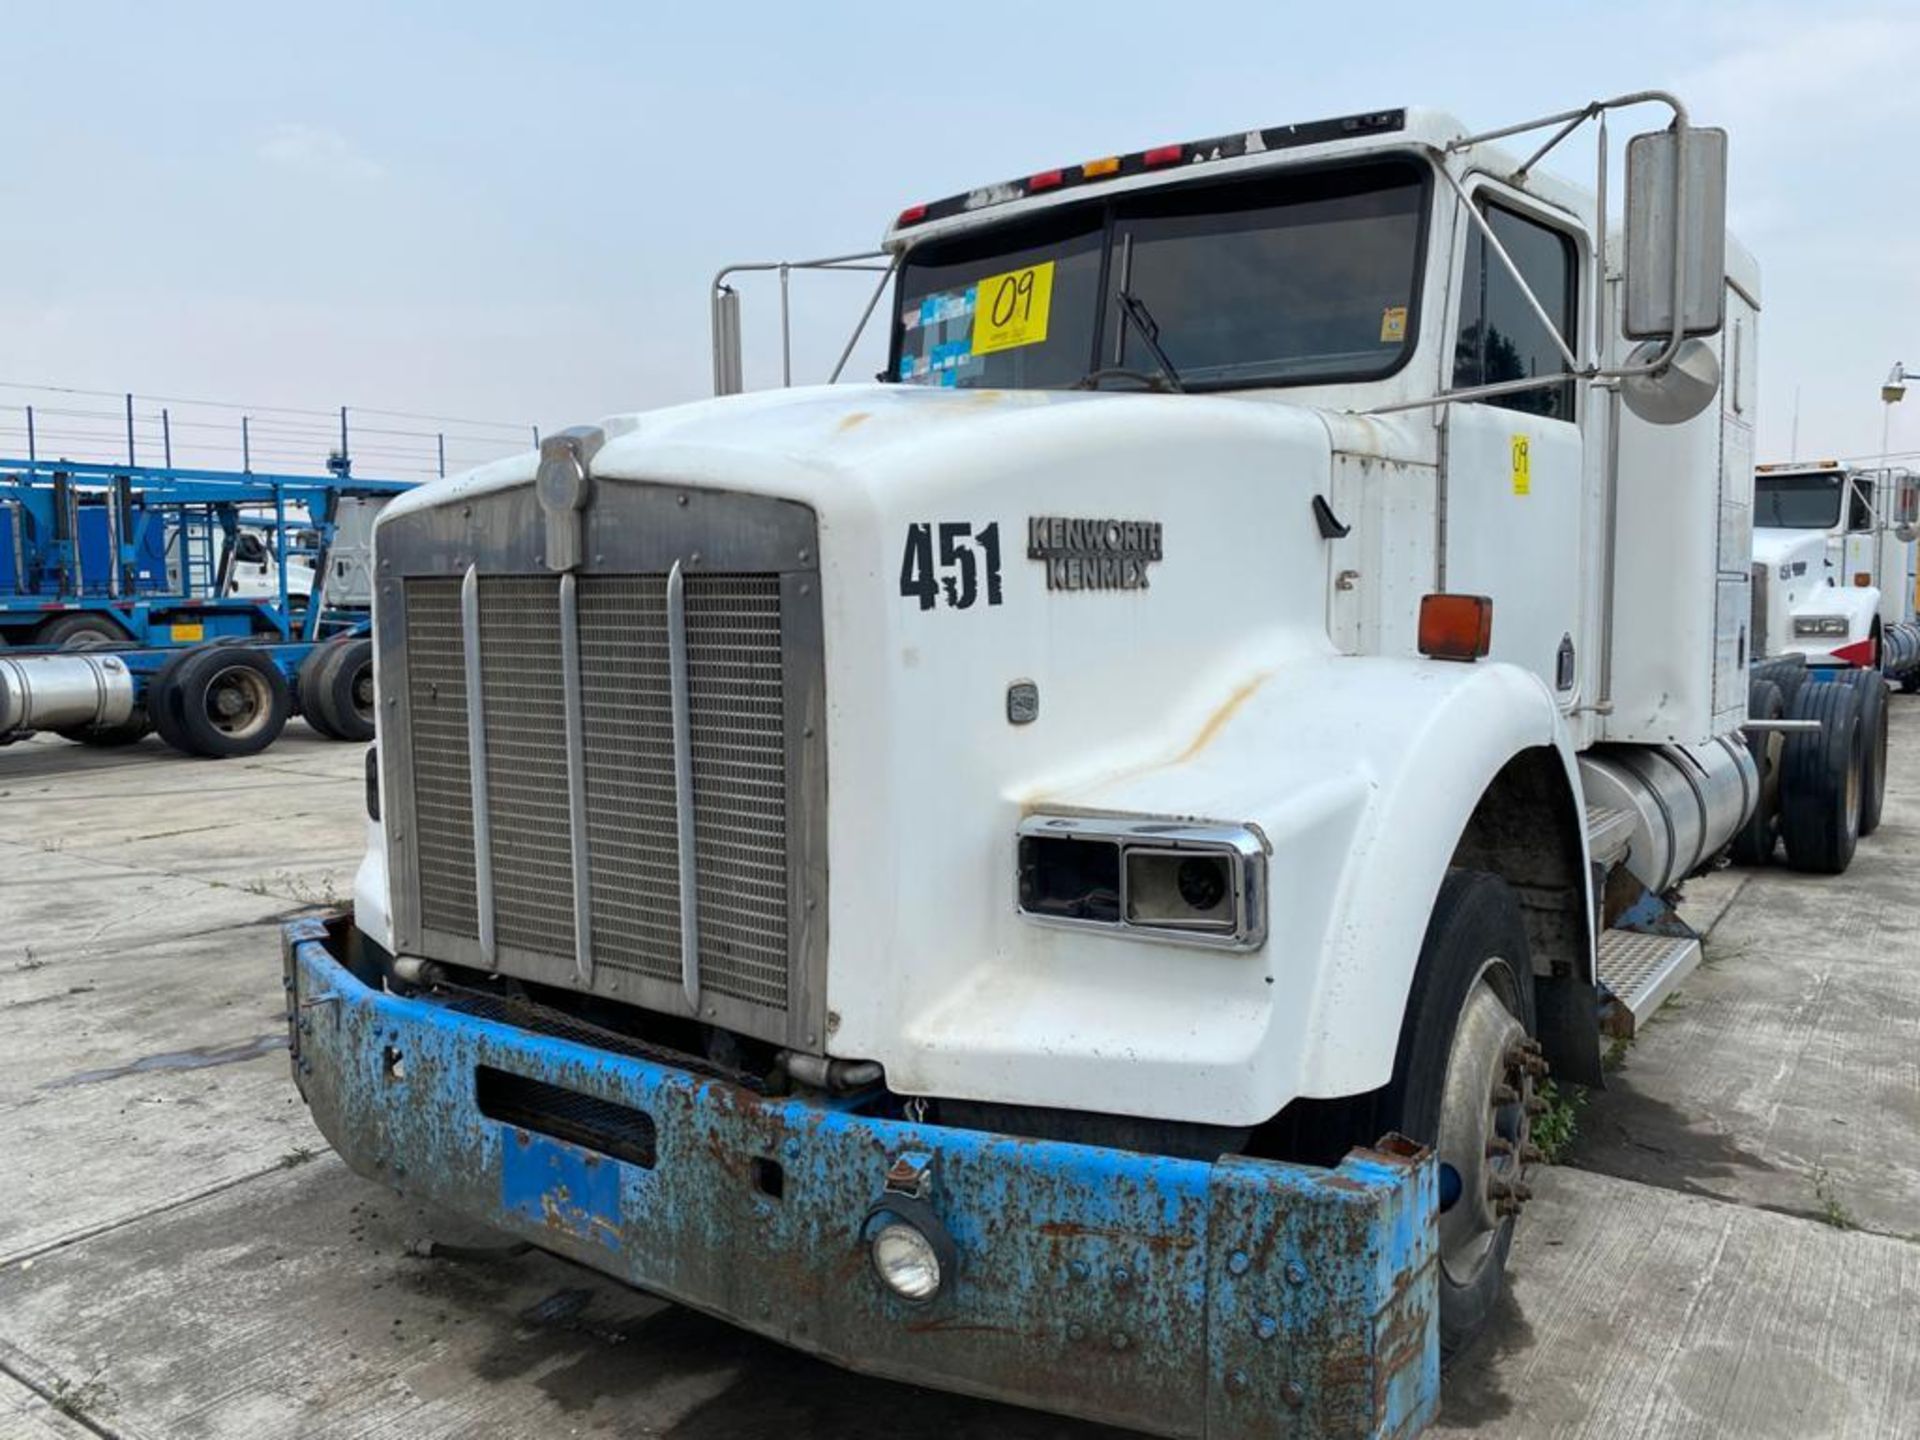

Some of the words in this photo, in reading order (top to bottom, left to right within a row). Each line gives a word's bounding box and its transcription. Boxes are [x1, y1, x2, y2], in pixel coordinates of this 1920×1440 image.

[991, 271, 1034, 327] 09
[1512, 441, 1529, 475] 09
[1028, 516, 1162, 552] KENWORTH
[900, 521, 1003, 612] 451
[1047, 556, 1150, 592] KENMEX
